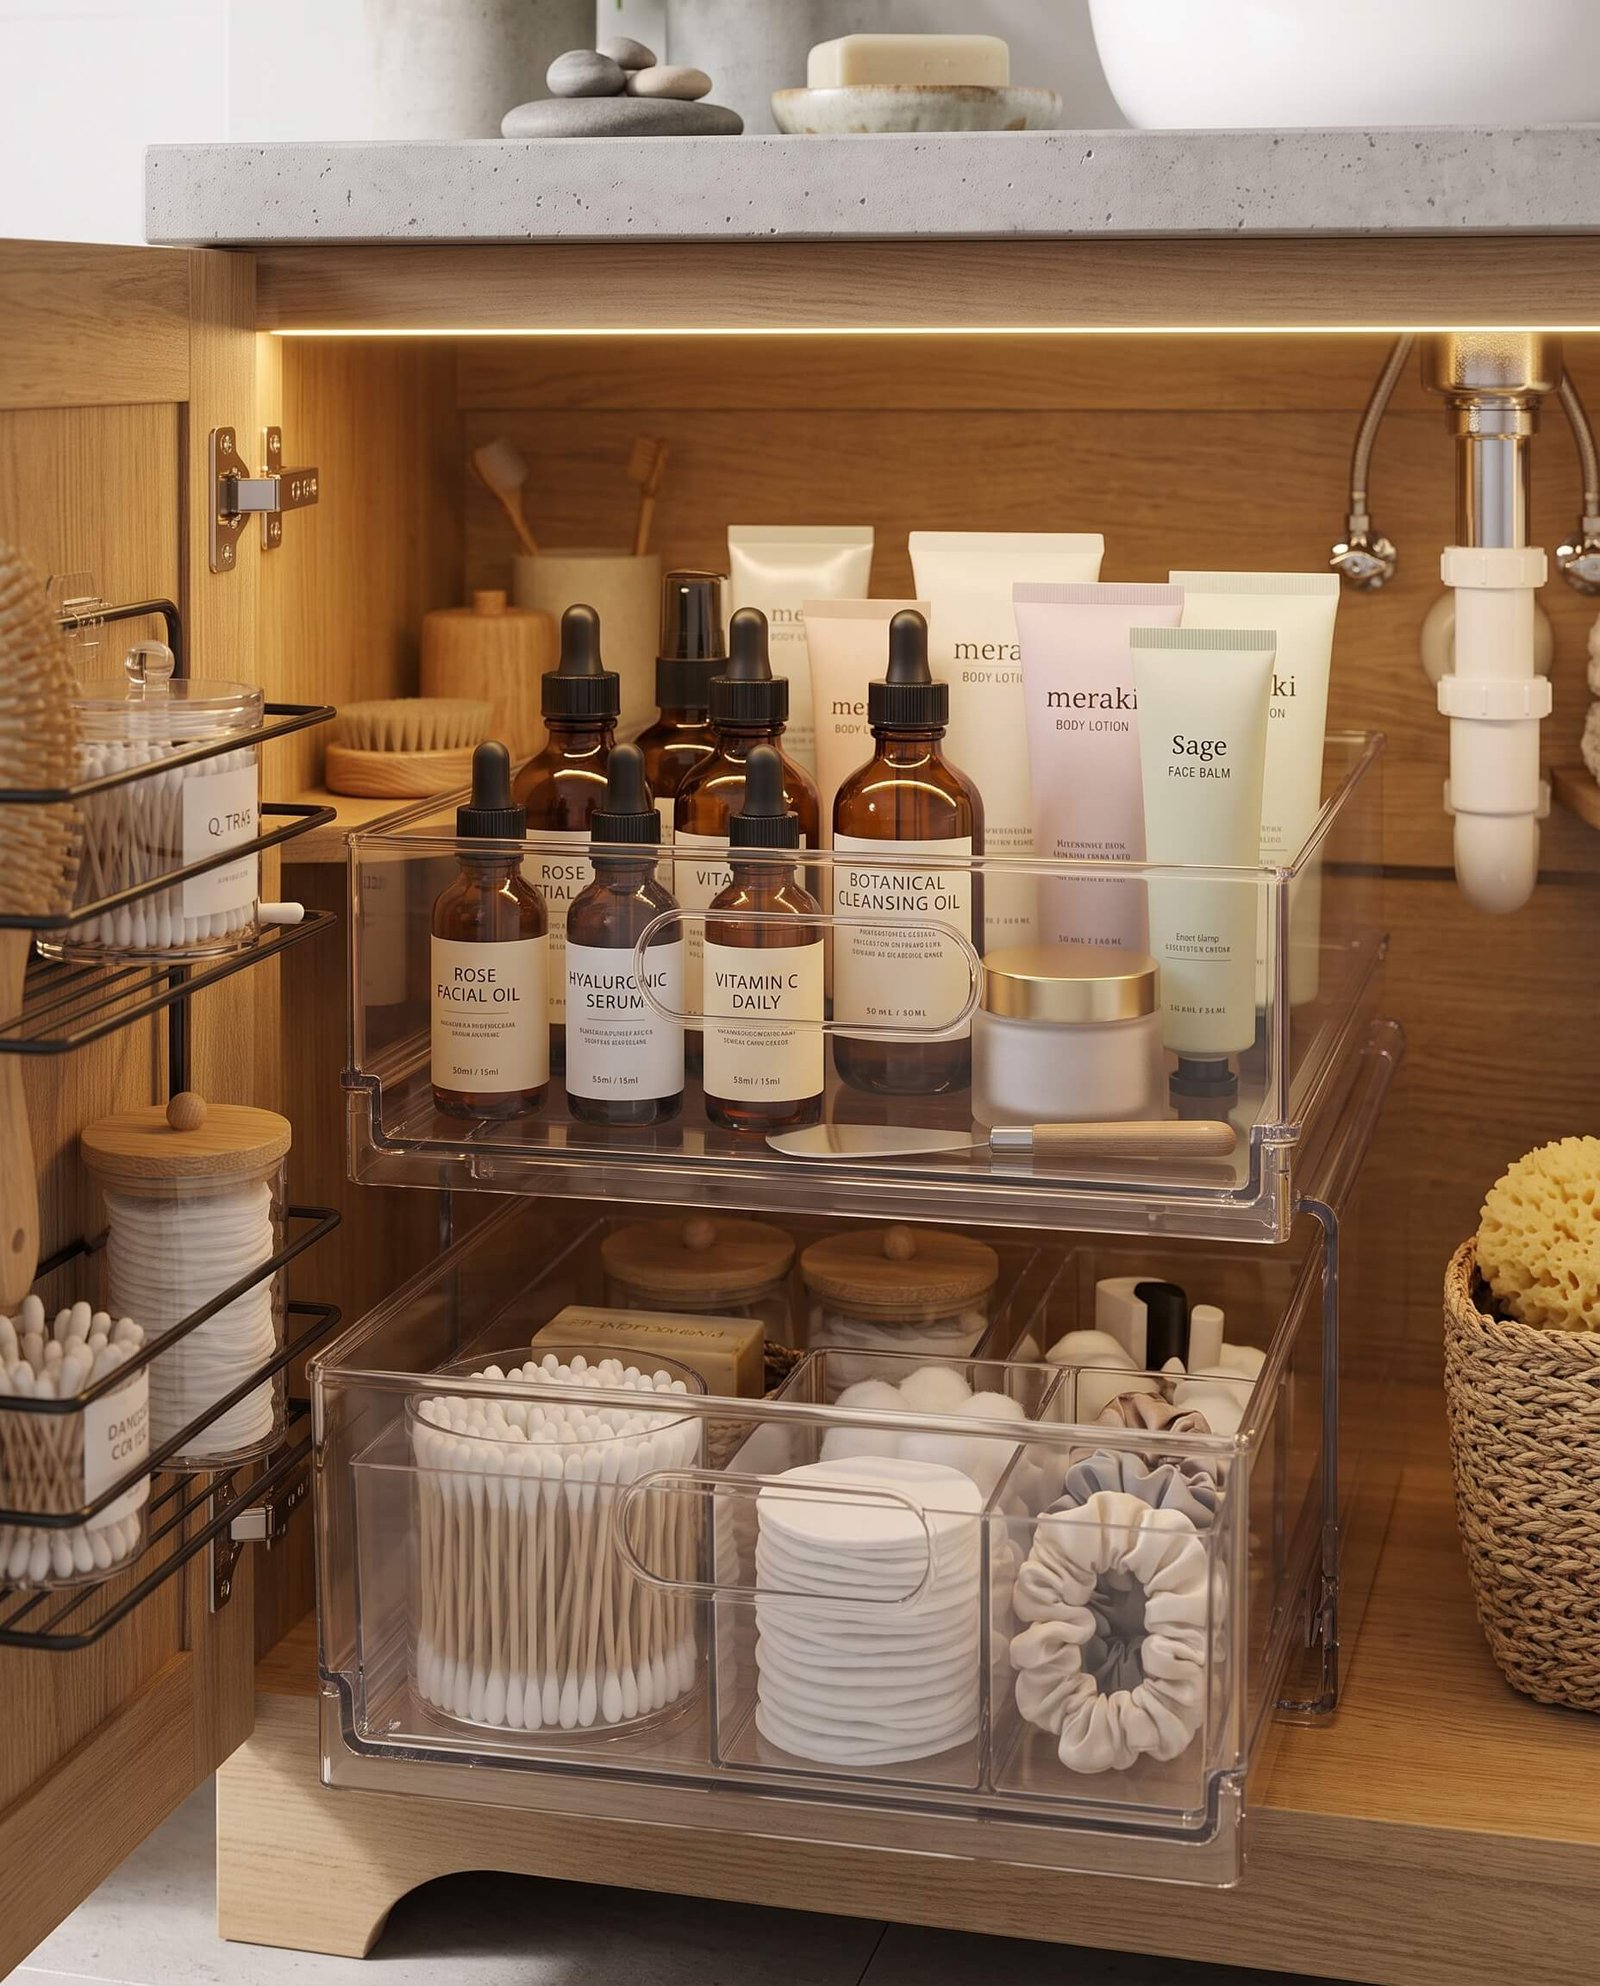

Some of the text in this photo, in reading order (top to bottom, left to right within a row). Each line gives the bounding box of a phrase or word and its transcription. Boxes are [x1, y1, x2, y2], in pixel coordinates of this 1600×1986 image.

[953, 643, 1021, 661] mera
[962, 671, 1024, 684] BODY LOTI
[1046, 687, 1138, 710] meraki
[834, 724, 861, 734] BODY
[1056, 719, 1129, 732] BODY LOTION
[1172, 735, 1227, 762] Sage
[1168, 766, 1231, 779] FACE BALM
[541, 865, 585, 880] ROSE
[850, 872, 945, 891] BOTANICAL
[838, 890, 960, 911] CLEANSING OIL
[454, 967, 497, 983] ROSE
[715, 972, 799, 991] VITAMIN C
[437, 984, 521, 1003] FACIAL OIL
[586, 993, 645, 1010] SERUM
[732, 994, 781, 1010] DAILY
